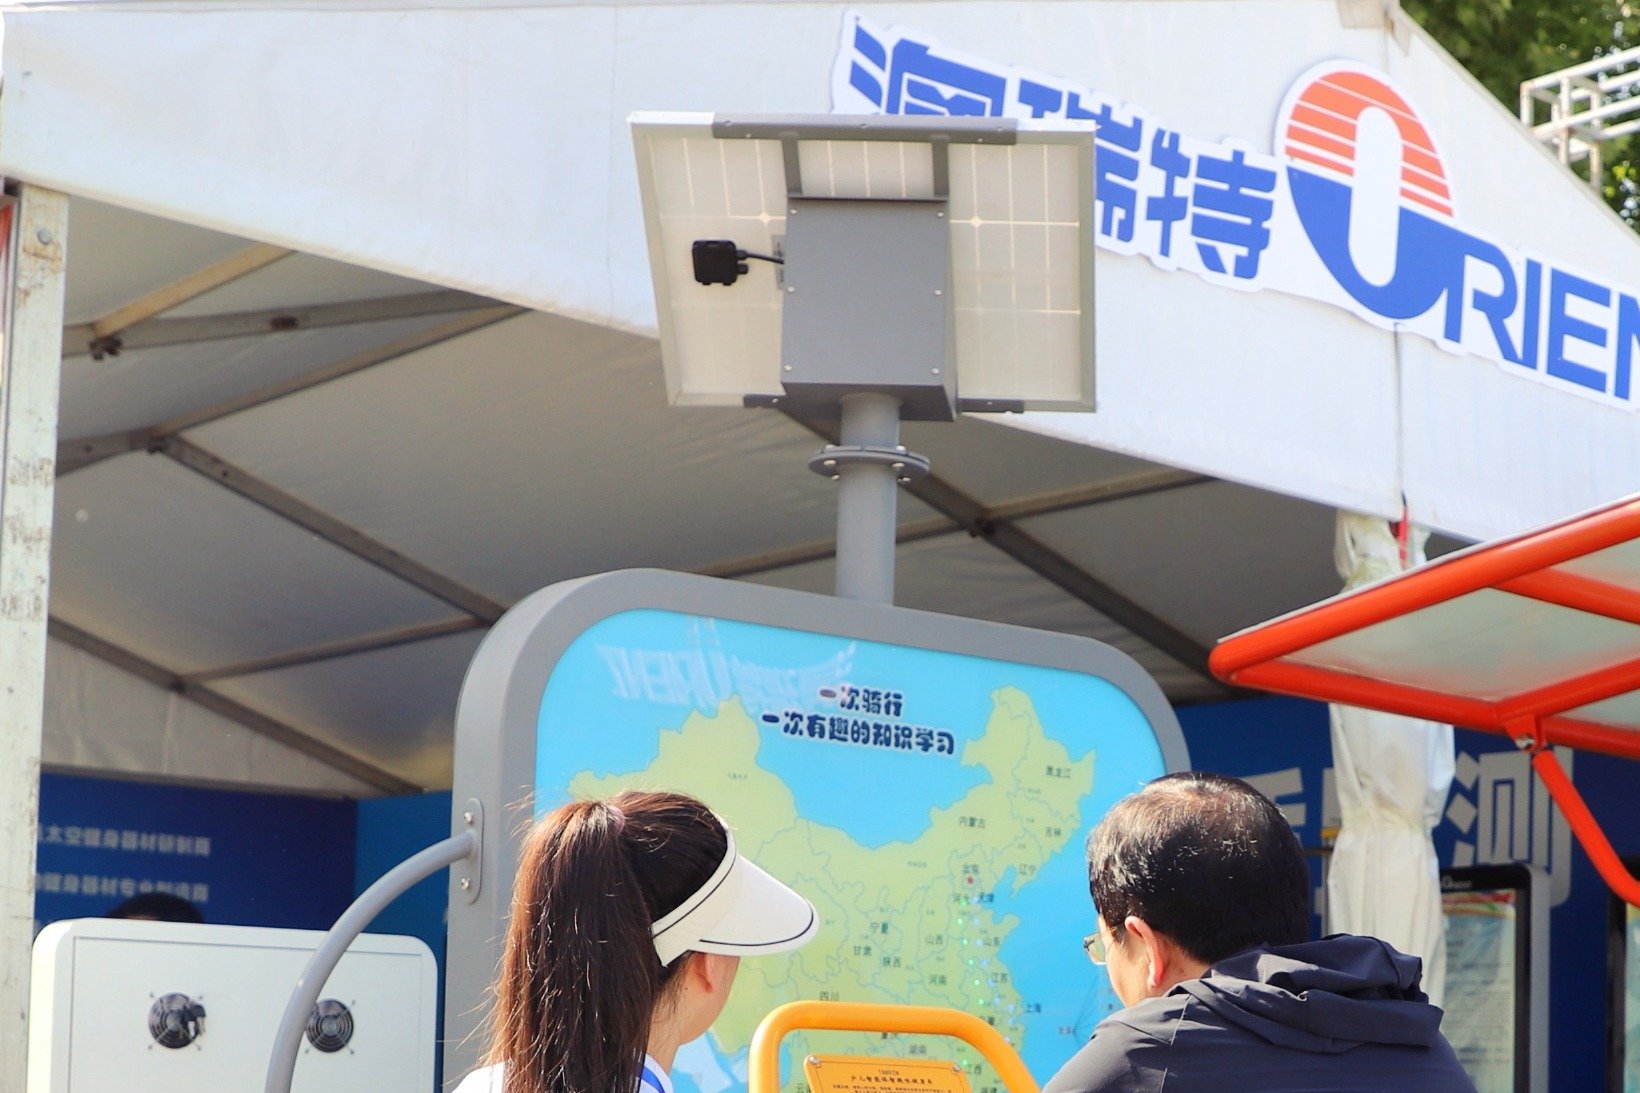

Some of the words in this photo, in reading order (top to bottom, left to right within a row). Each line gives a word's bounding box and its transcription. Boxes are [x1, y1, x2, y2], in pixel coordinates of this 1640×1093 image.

[819, 684, 903, 717] 一次骑行
[761, 710, 955, 755] 一次有趣的知识学习
[1046, 765, 1072, 779] 黑龙江
[959, 815, 986, 829] 内蒙古
[1019, 863, 1036, 876] 辽宁
[869, 921, 889, 934] 宁夏
[925, 934, 944, 946] 山西
[819, 991, 839, 1002] 四川
[1025, 1002, 1042, 1014] 上海
